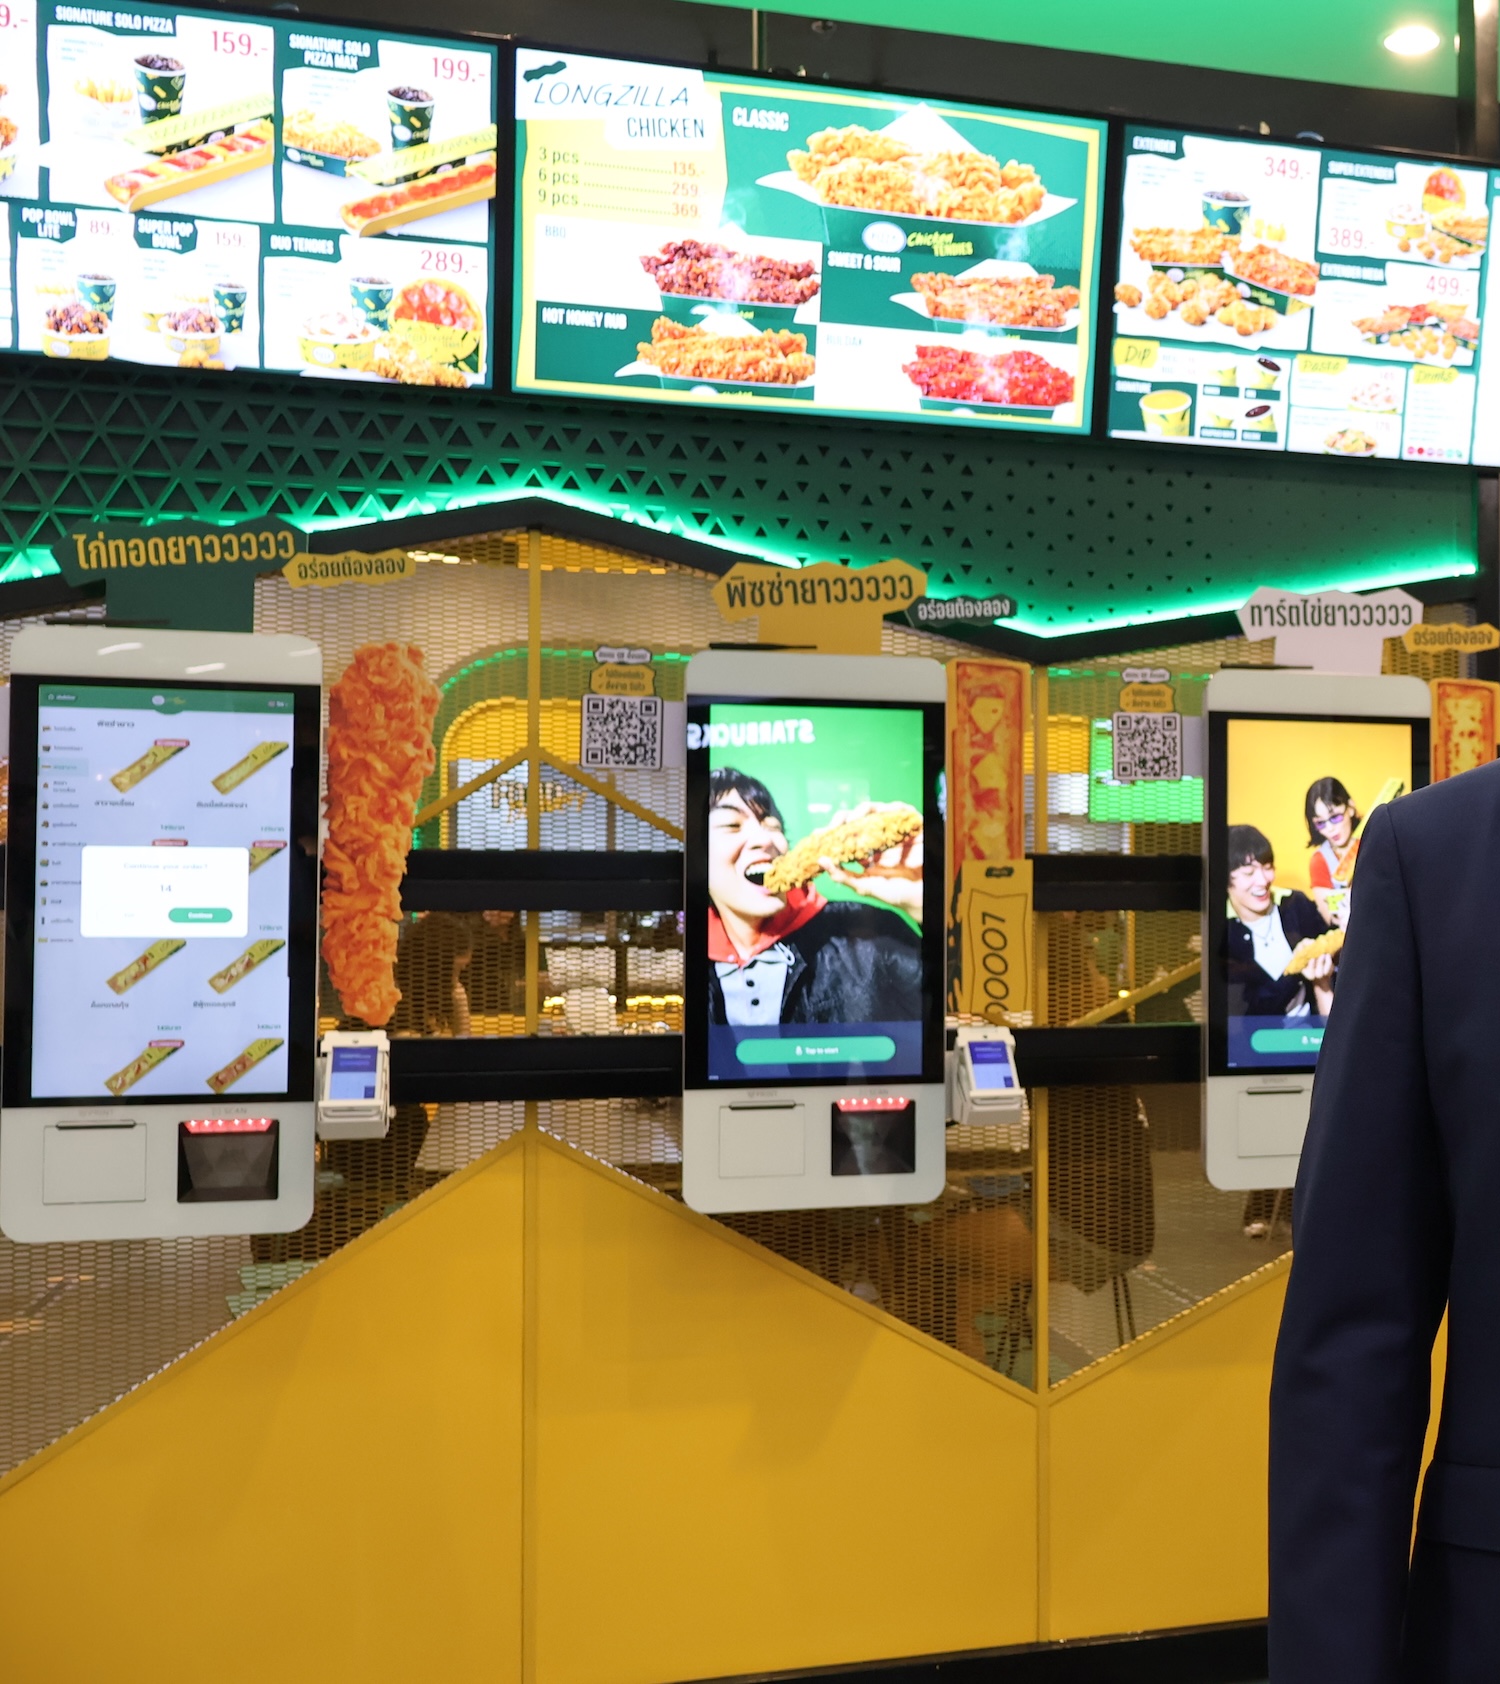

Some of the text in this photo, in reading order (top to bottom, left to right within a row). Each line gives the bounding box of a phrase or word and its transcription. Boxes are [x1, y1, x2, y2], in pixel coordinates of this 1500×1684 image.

[55, 5, 175, 34] SIGNATURE SOLO PIZZA
[211, 30, 268, 57] 159.-
[289, 34, 371, 58] SIGNATURE SOLO
[304, 51, 358, 71] PIZZA MAX
[432, 57, 485, 82] 199.-
[533, 82, 689, 107] LONGZILLA
[626, 117, 705, 138] CHICKEN
[732, 106, 790, 132] CLASSIC
[538, 146, 547, 161] 3
[552, 151, 580, 166] pcs
[1264, 156, 1311, 180] 349.-
[538, 167, 547, 182] 6
[552, 172, 580, 186] pcs
[538, 188, 547, 203] 9
[551, 193, 579, 207] pcs
[21, 207, 76, 227] POP BOWL
[138, 218, 194, 237] SUPER POP
[37, 222, 61, 239] LITE
[151, 233, 182, 251] BOWL
[270, 235, 335, 255] DUO TENDIES
[420, 249, 478, 274] 289.-
[827, 250, 862, 269] SWEET
[873, 255, 902, 273] SOUR
[541, 306, 628, 330] HOT HONEY RUB
[72, 529, 295, 570] ไก่ทอดยาววววว
[297, 556, 406, 580] อร่อยต้องลอง
[726, 572, 914, 609] พิซซ่ายาววววว
[917, 597, 1010, 621] อร่อยต้องลอง
[1250, 598, 1413, 627] ทาร์ตไข่ยาววววว
